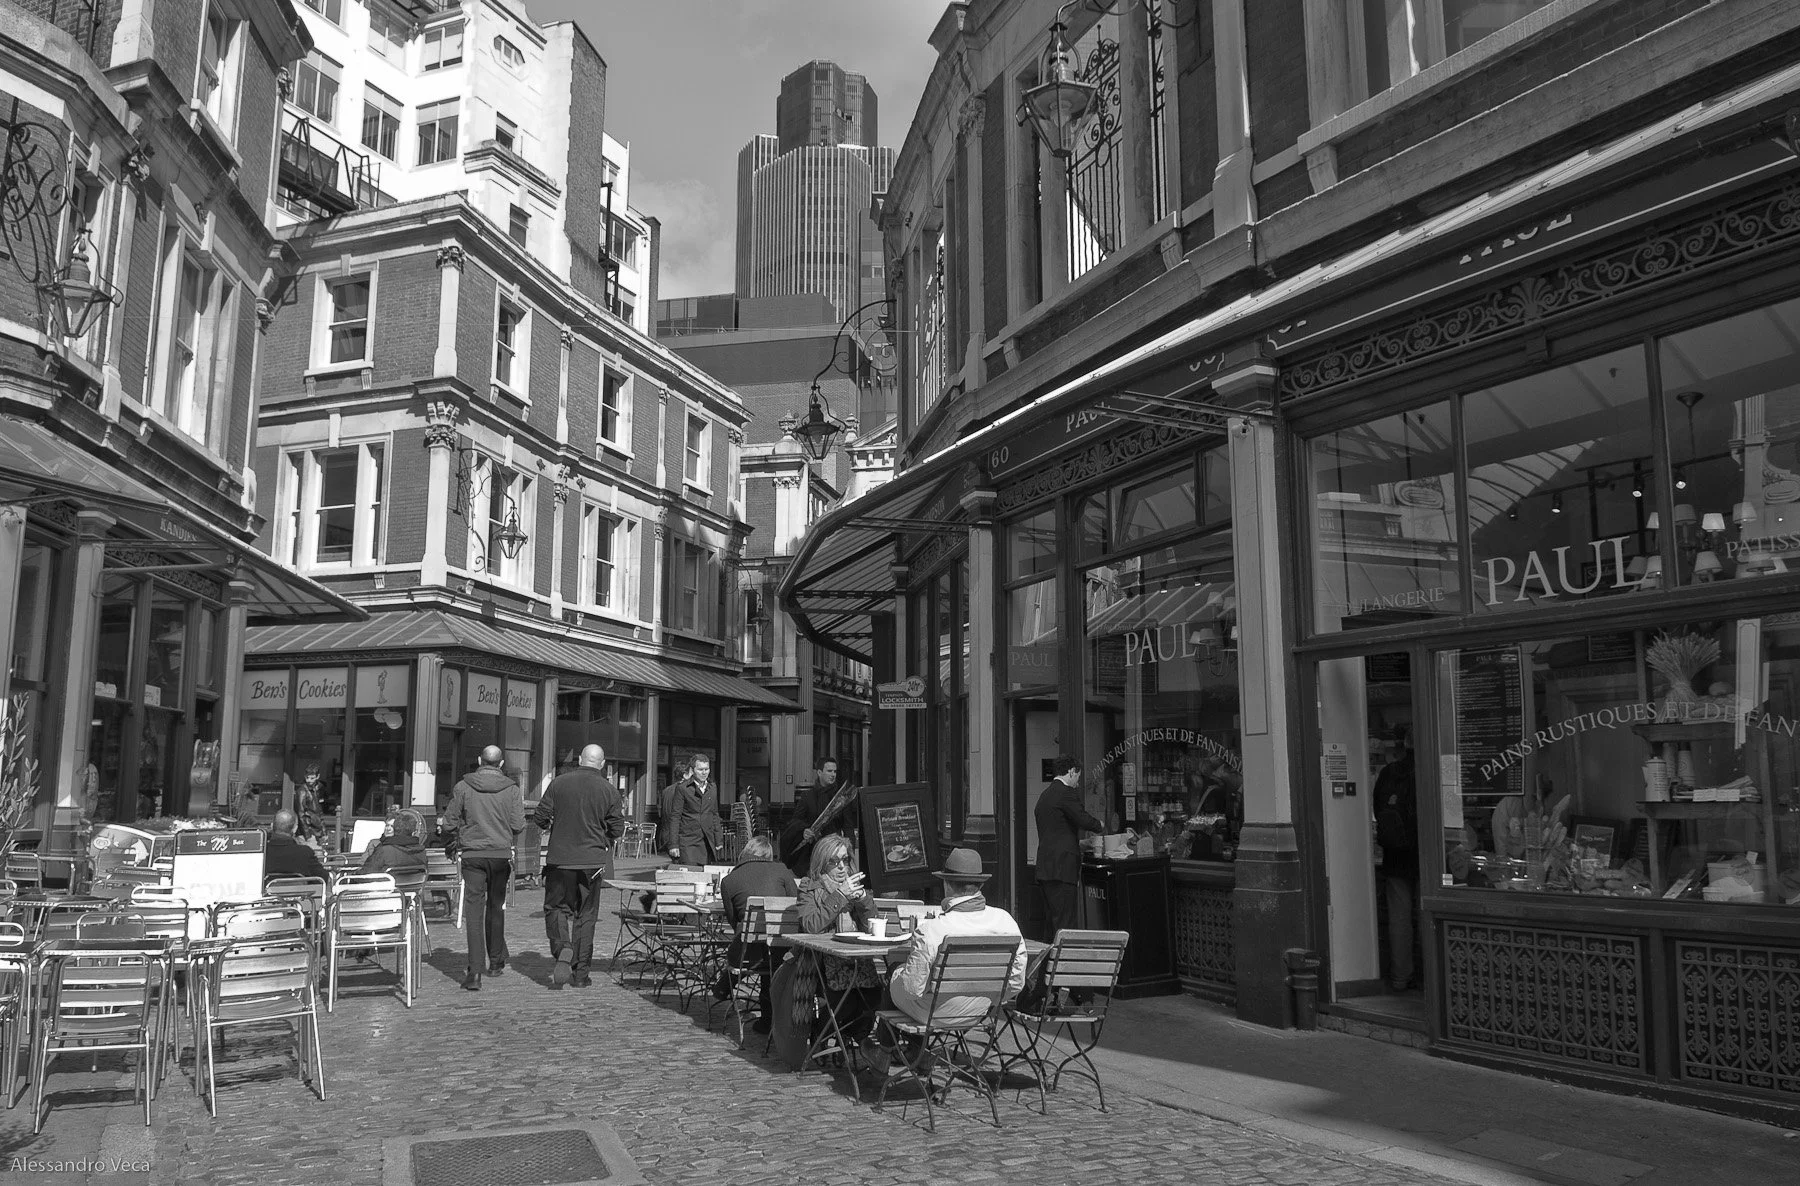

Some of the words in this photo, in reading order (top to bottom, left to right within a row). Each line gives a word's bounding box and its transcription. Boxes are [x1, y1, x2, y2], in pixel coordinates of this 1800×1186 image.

[991, 446, 1009, 468] 60
[1482, 535, 1649, 606] PAUL
[1338, 587, 1445, 616] ULANGERIE
[1123, 622, 1197, 667] PAUL
[1010, 651, 1055, 667] PAUL
[251, 680, 287, 699] Ben's
[299, 678, 347, 699] Cookies
[477, 684, 500, 705] Ben's
[507, 689, 532, 709] Cookies
[1092, 752, 1114, 779] PAINS
[1114, 728, 1163, 758] RUSTIQUES
[1166, 727, 1178, 740] ET
[1180, 729, 1194, 744] DE
[1196, 734, 1243, 776] FANTAISI
[1480, 738, 1533, 781] PAINS
[1534, 702, 1657, 748] RUSTIQUES
[1666, 701, 1694, 719] ET
[1745, 709, 1800, 738] FAN
[1088, 886, 1106, 900] PAUL
